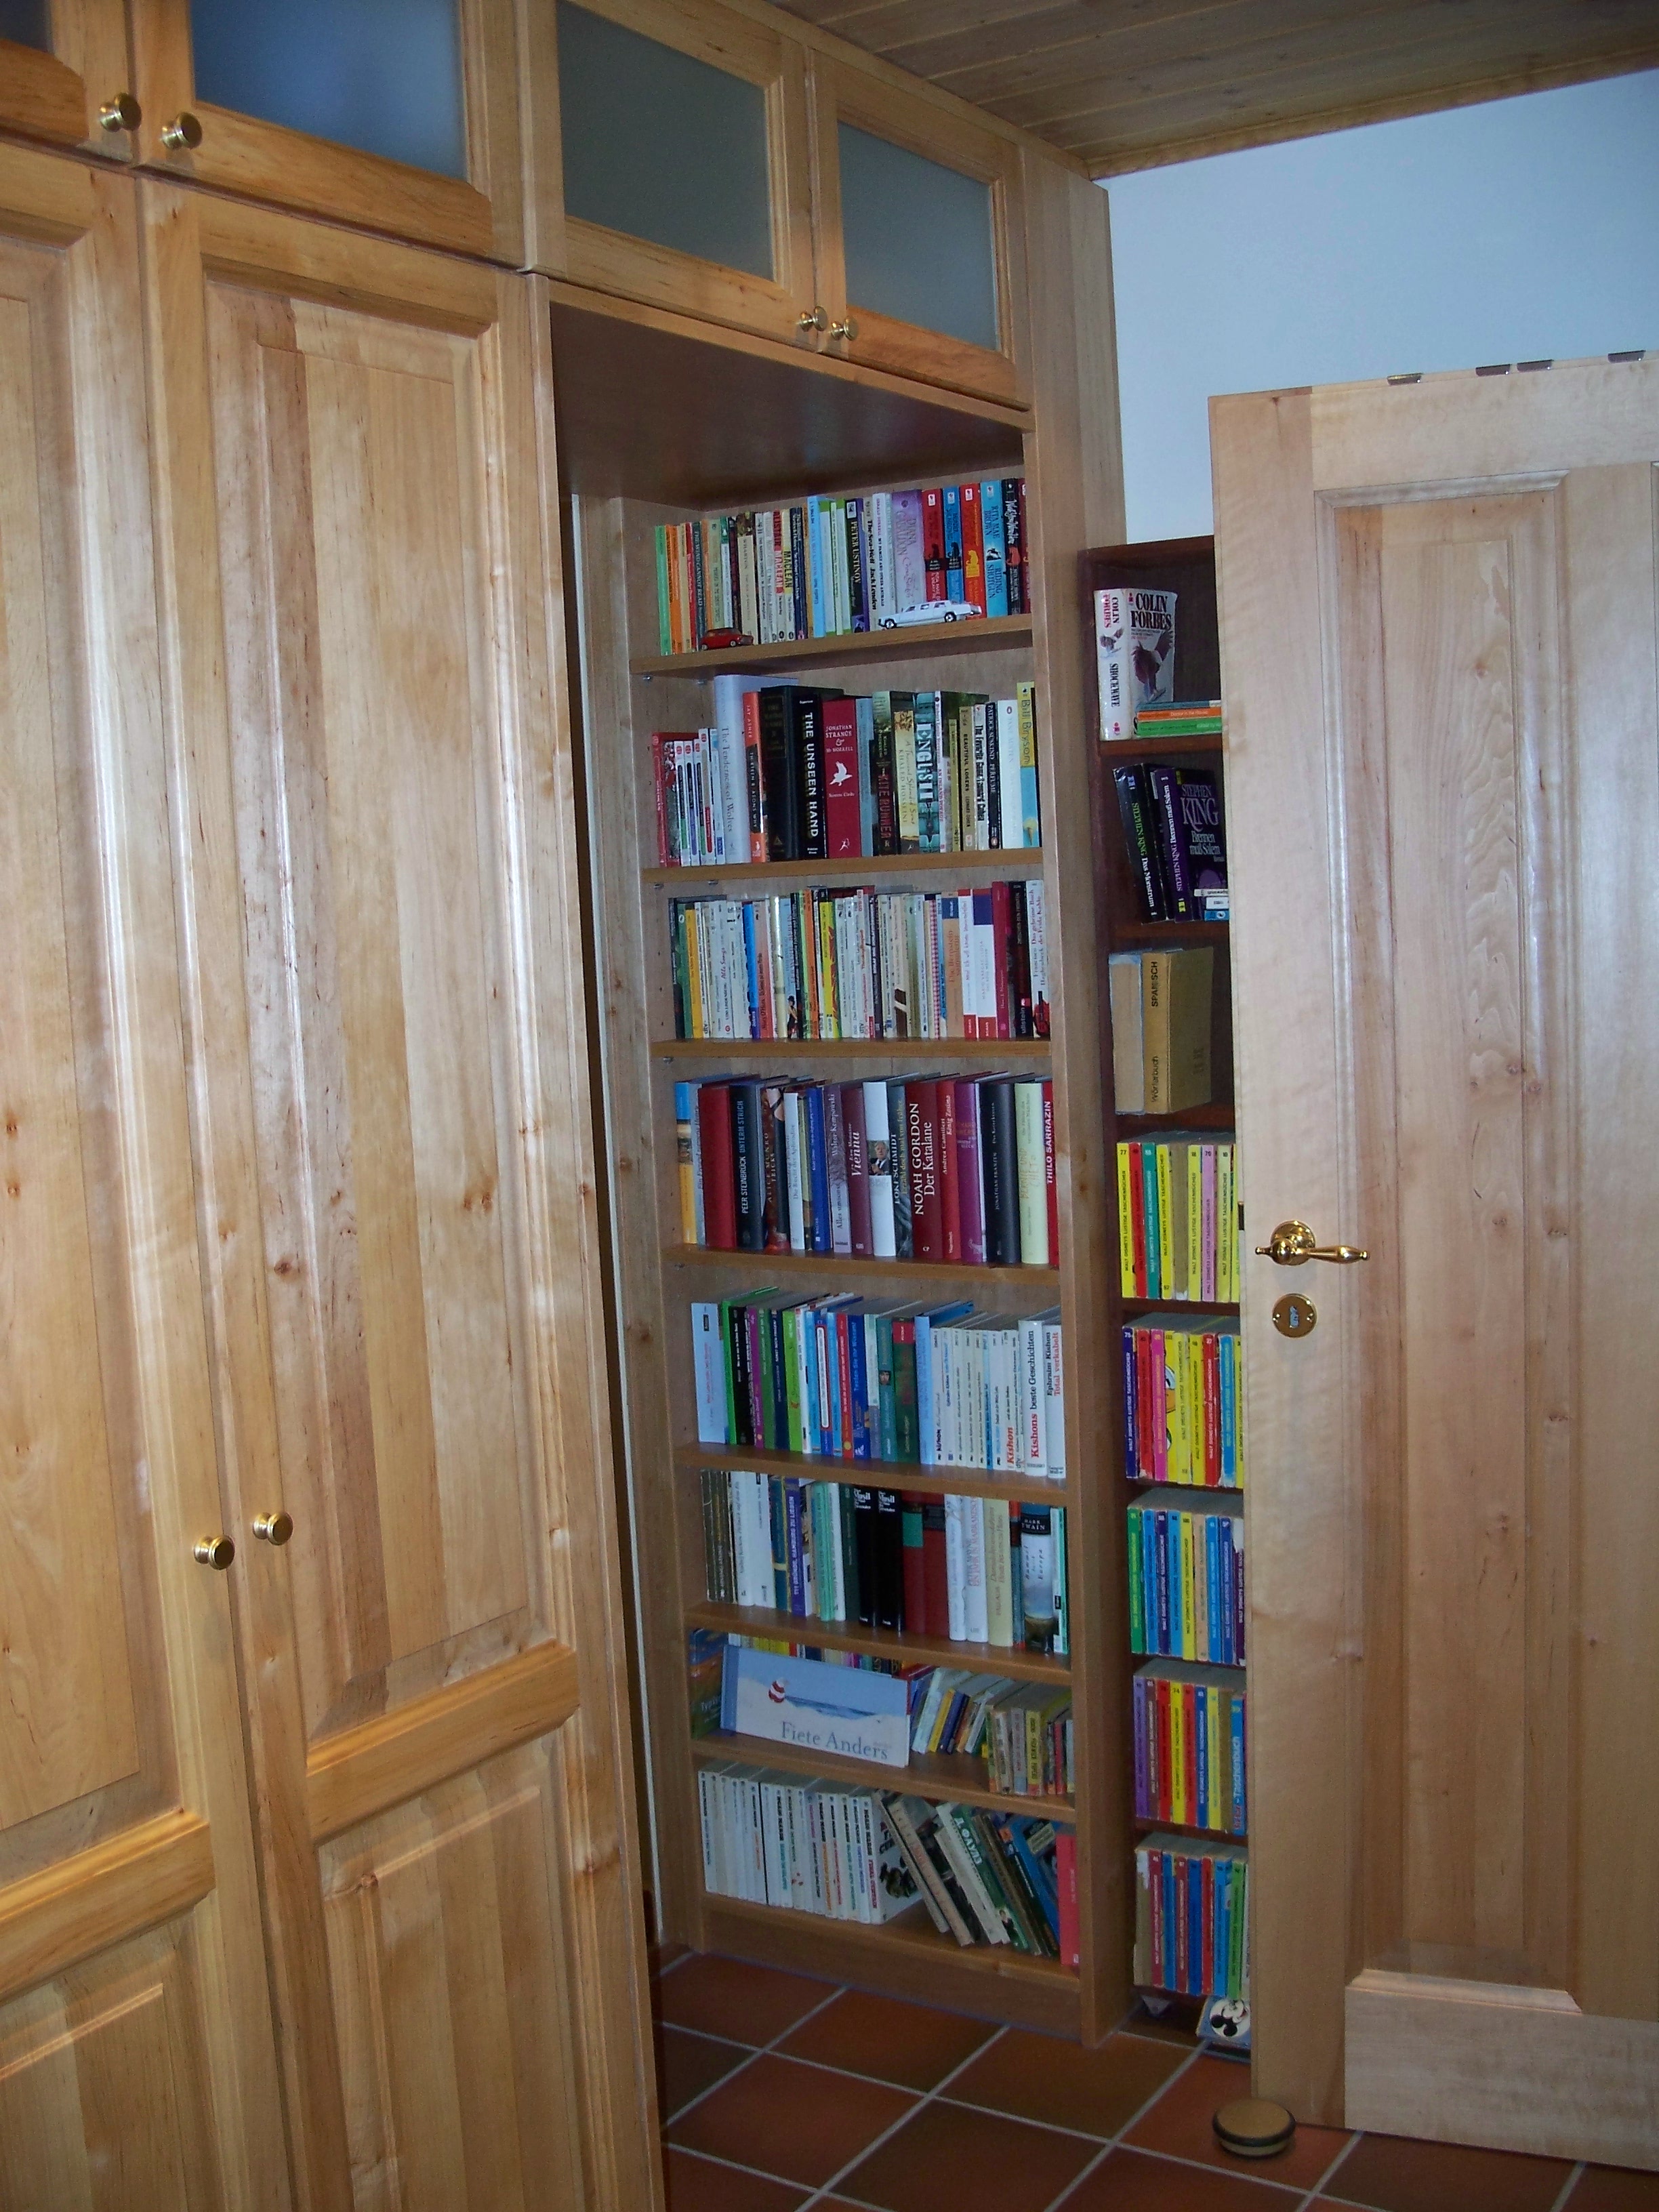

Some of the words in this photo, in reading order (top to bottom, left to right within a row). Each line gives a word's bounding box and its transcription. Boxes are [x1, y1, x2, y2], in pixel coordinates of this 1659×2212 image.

[851, 521, 859, 548] PETER
[775, 551, 783, 588] MACLEAN
[784, 551, 793, 588] MACLEAN
[852, 548, 861, 584] USTINOV
[1111, 596, 1120, 624] COLIN
[1135, 593, 1168, 612] COLIN
[1130, 611, 1172, 630] FORBES
[805, 712, 814, 738] THE
[1021, 699, 1031, 720] Bill
[722, 726, 731, 743] The
[975, 724, 983, 735] The
[1022, 721, 1033, 764] Bryson
[806, 743, 817, 796] UNSEEN
[725, 791, 733, 800] of
[1181, 783, 1212, 797] STEPHEN
[726, 802, 735, 832] Wolves
[809, 801, 819, 838] HAND
[1180, 797, 1219, 831] KING
[1191, 831, 1215, 843] Brennen
[738, 1126, 746, 1153] UNTERM
[909, 1103, 922, 1169] GORDON
[1044, 1101, 1052, 1153] SARRAZIN
[851, 1131, 862, 1176] Vienna
[890, 1133, 898, 1179] SCHMIDT
[922, 1122, 935, 1171] Katalane
[913, 1173, 924, 1216] NOAH
[923, 1173, 935, 1195] Der
[741, 1197, 749, 1214] PEER
[1027, 1330, 1037, 1386] Geschichten
[1052, 1332, 1061, 1372] verkabelt
[1029, 1387, 1037, 1410] beste
[1030, 1414, 1039, 1458] Kishons
[1021, 1523, 1045, 1531] TWAIN
[781, 1720, 821, 1746] Fiete
[825, 1730, 889, 1761] Anders
